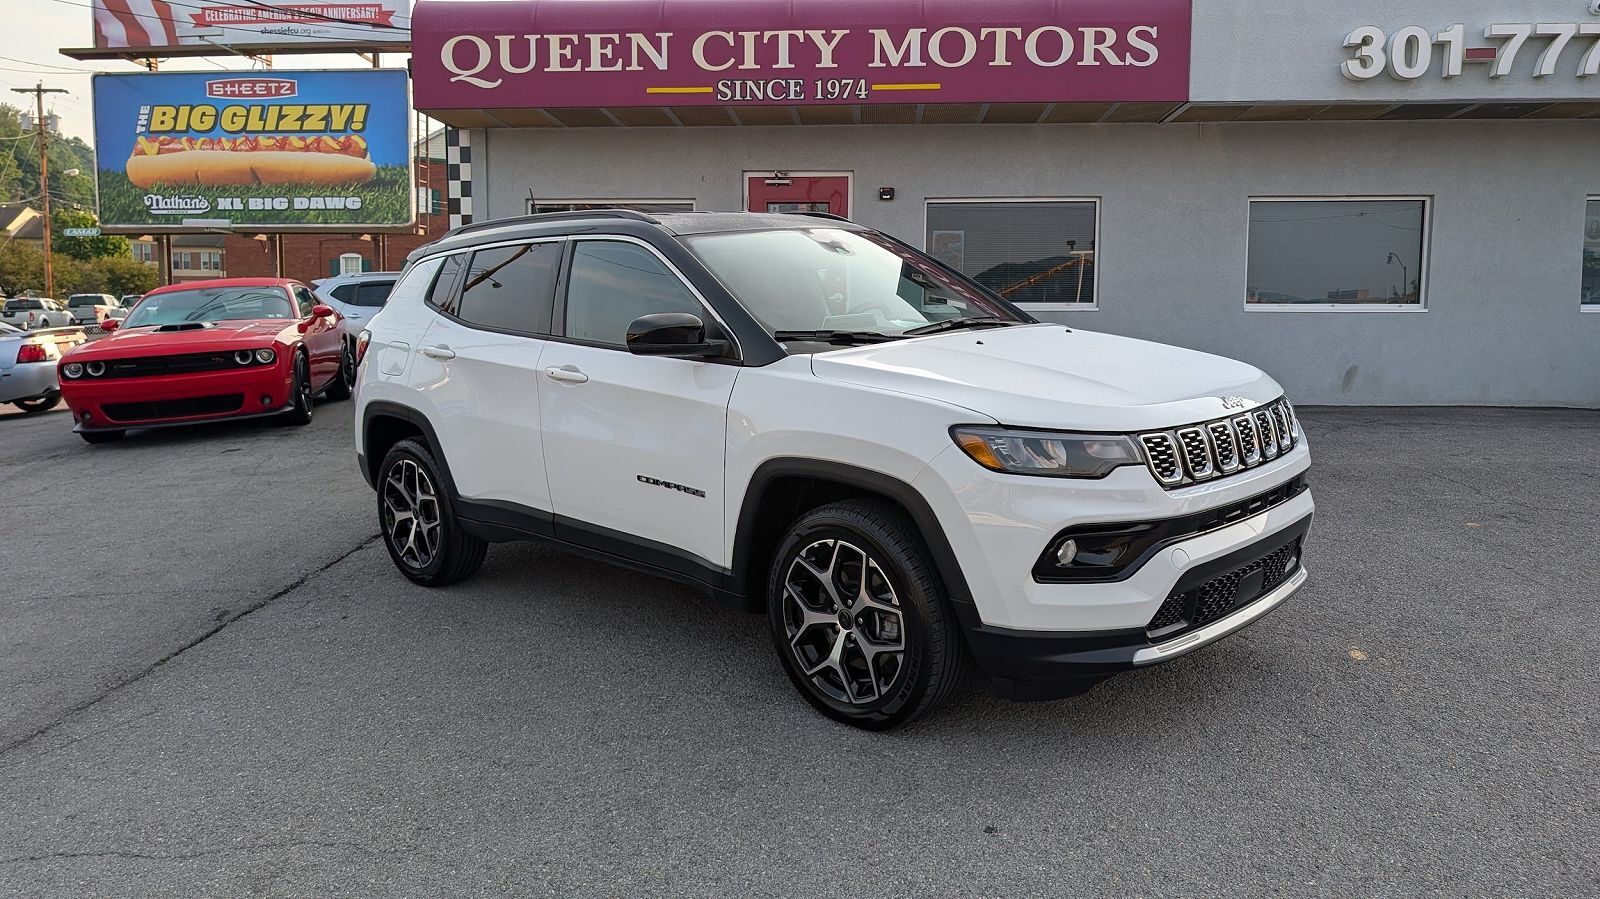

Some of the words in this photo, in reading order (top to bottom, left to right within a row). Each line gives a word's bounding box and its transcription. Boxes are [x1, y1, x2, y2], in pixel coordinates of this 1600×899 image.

[205, 10, 256, 22] CELEBRATING
[324, 7, 379, 19] ANNIVERSARY!
[440, 32, 673, 89] QUEEN
[691, 29, 850, 71] CITY
[868, 26, 1160, 69] MOTORS
[212, 82, 292, 95] SHEETZ
[716, 80, 805, 101] SINCE
[813, 79, 869, 100] 1974
[136, 105, 150, 133] THE
[150, 104, 216, 133] BIG
[220, 104, 370, 132] GLIZZY!
[143, 194, 211, 213] Nathan's
[216, 196, 243, 210] XL
[248, 197, 291, 210] BIG
[294, 196, 363, 210] DAWG
[1221, 396, 1245, 409] Jeep
[637, 475, 706, 498] COMPASS
